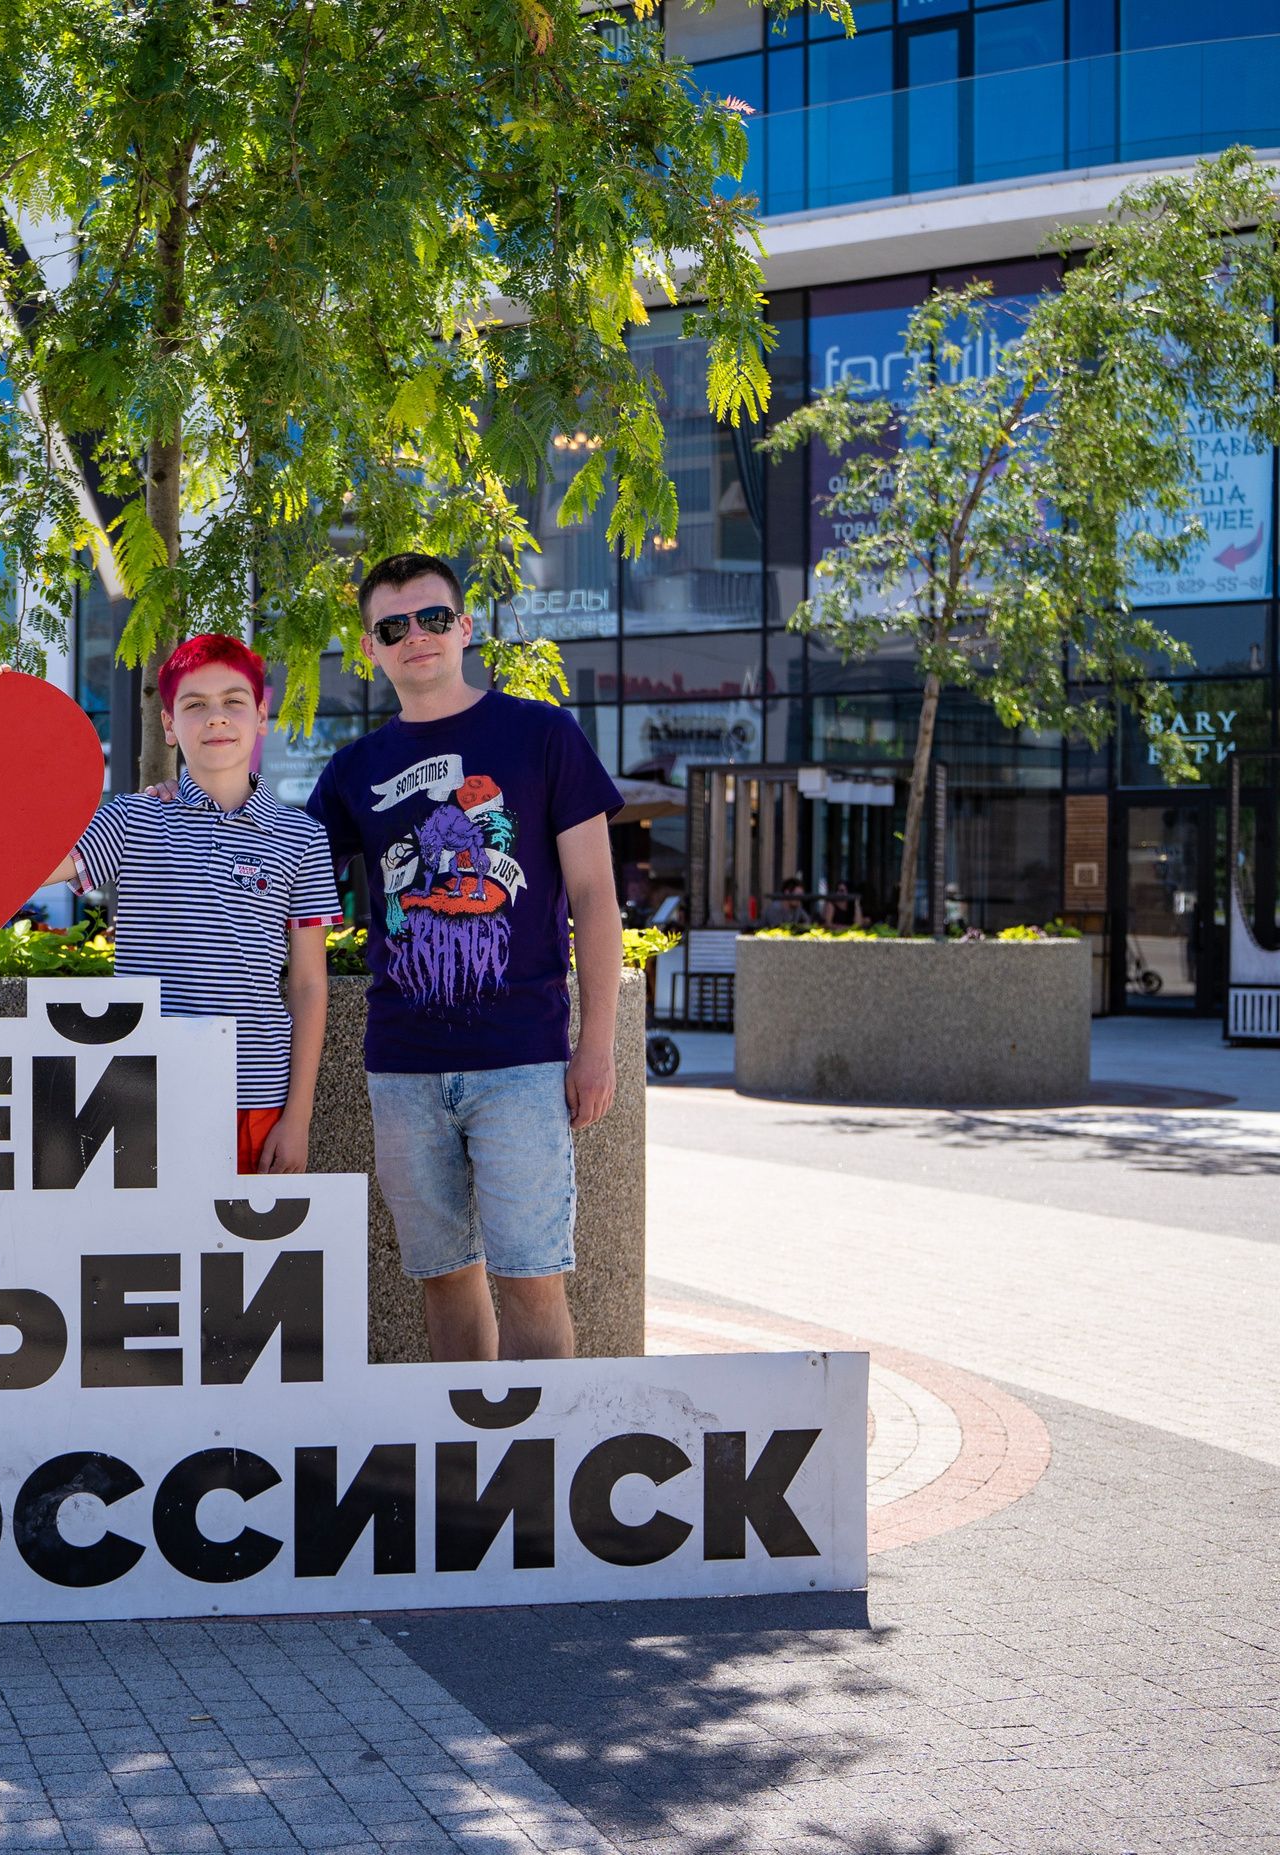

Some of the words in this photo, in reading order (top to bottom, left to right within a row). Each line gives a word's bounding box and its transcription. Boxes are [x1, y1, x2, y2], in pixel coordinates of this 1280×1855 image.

[511, 588, 609, 616] ОБЕДЫ
[1149, 710, 1238, 735] BARY
[1147, 741, 1237, 765] БРИ
[395, 758, 449, 798] SOMETIMES
[492, 857, 520, 887] JUST
[385, 912, 512, 1007] STRANGE
